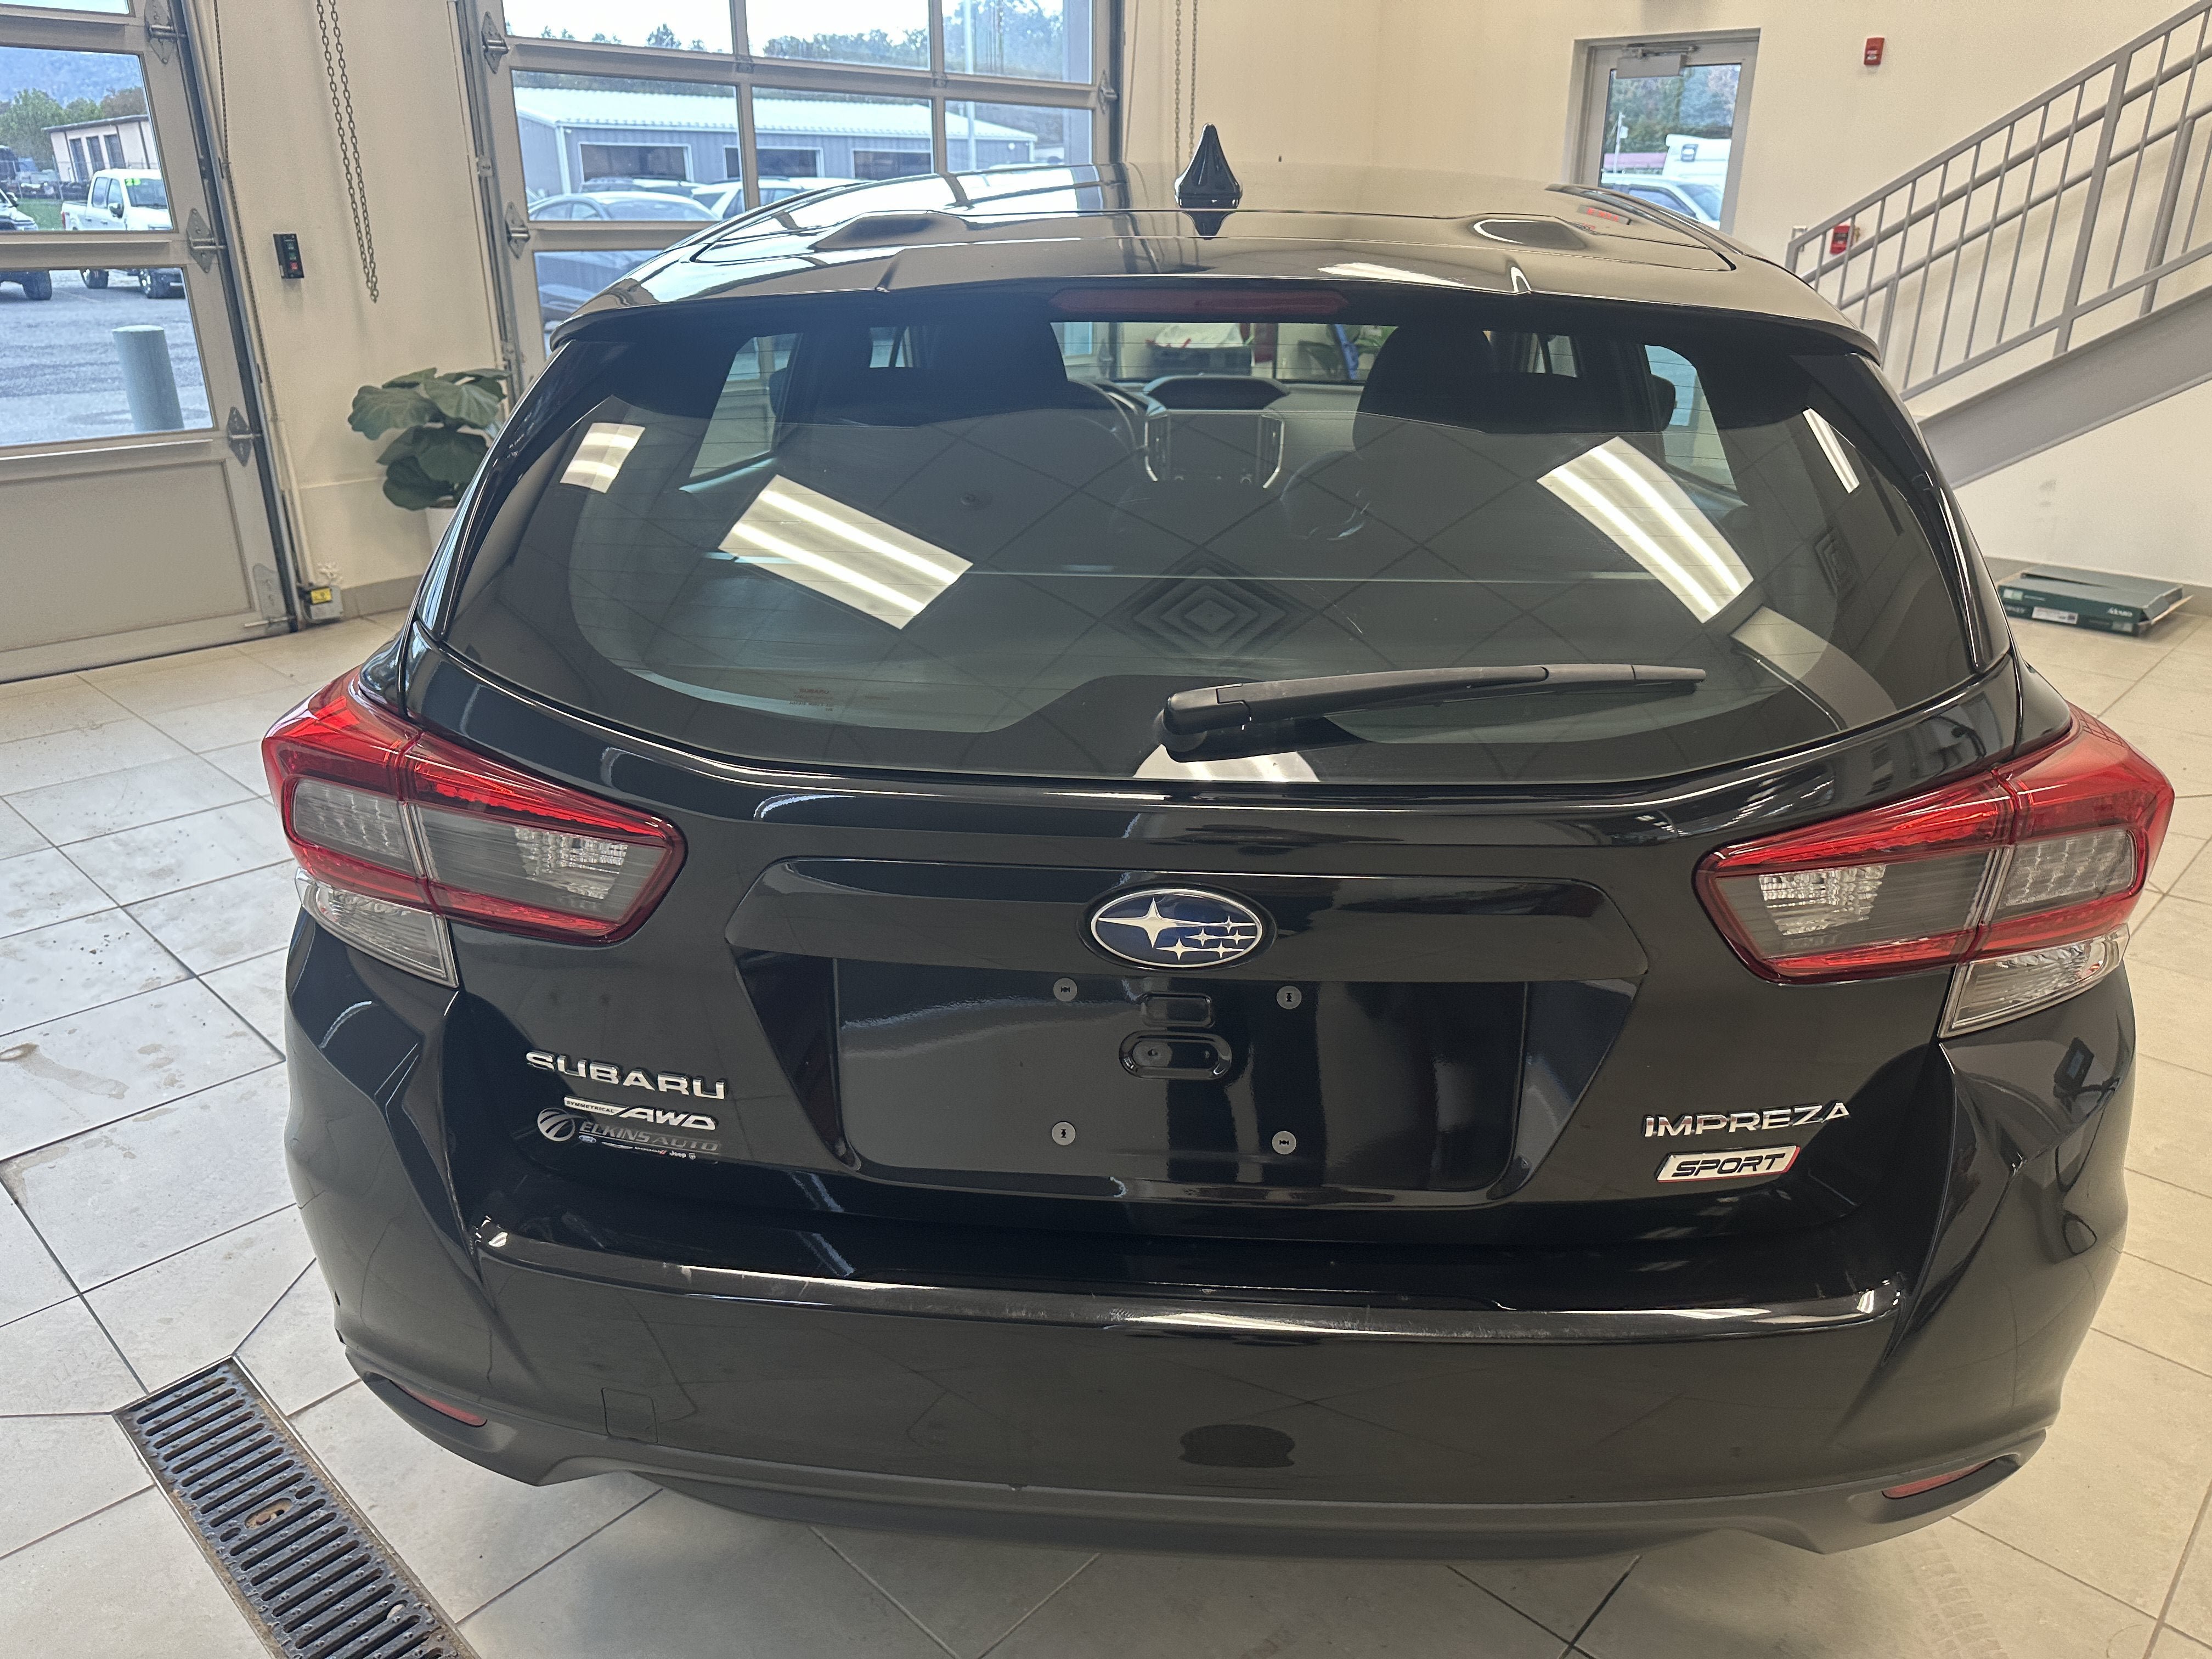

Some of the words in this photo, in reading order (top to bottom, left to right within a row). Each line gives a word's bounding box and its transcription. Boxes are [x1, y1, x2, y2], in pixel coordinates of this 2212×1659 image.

[525, 1051, 726, 1099] SUBARU
[566, 1101, 615, 1114] SYMMETRICAL
[618, 1107, 717, 1131] AWD
[1643, 1102, 1849, 1137] IMPREZA
[579, 1121, 652, 1143] ELKINS
[652, 1136, 720, 1152] AUTO
[669, 1150, 687, 1159] Jeep
[1672, 1152, 1787, 1178] SPORT
